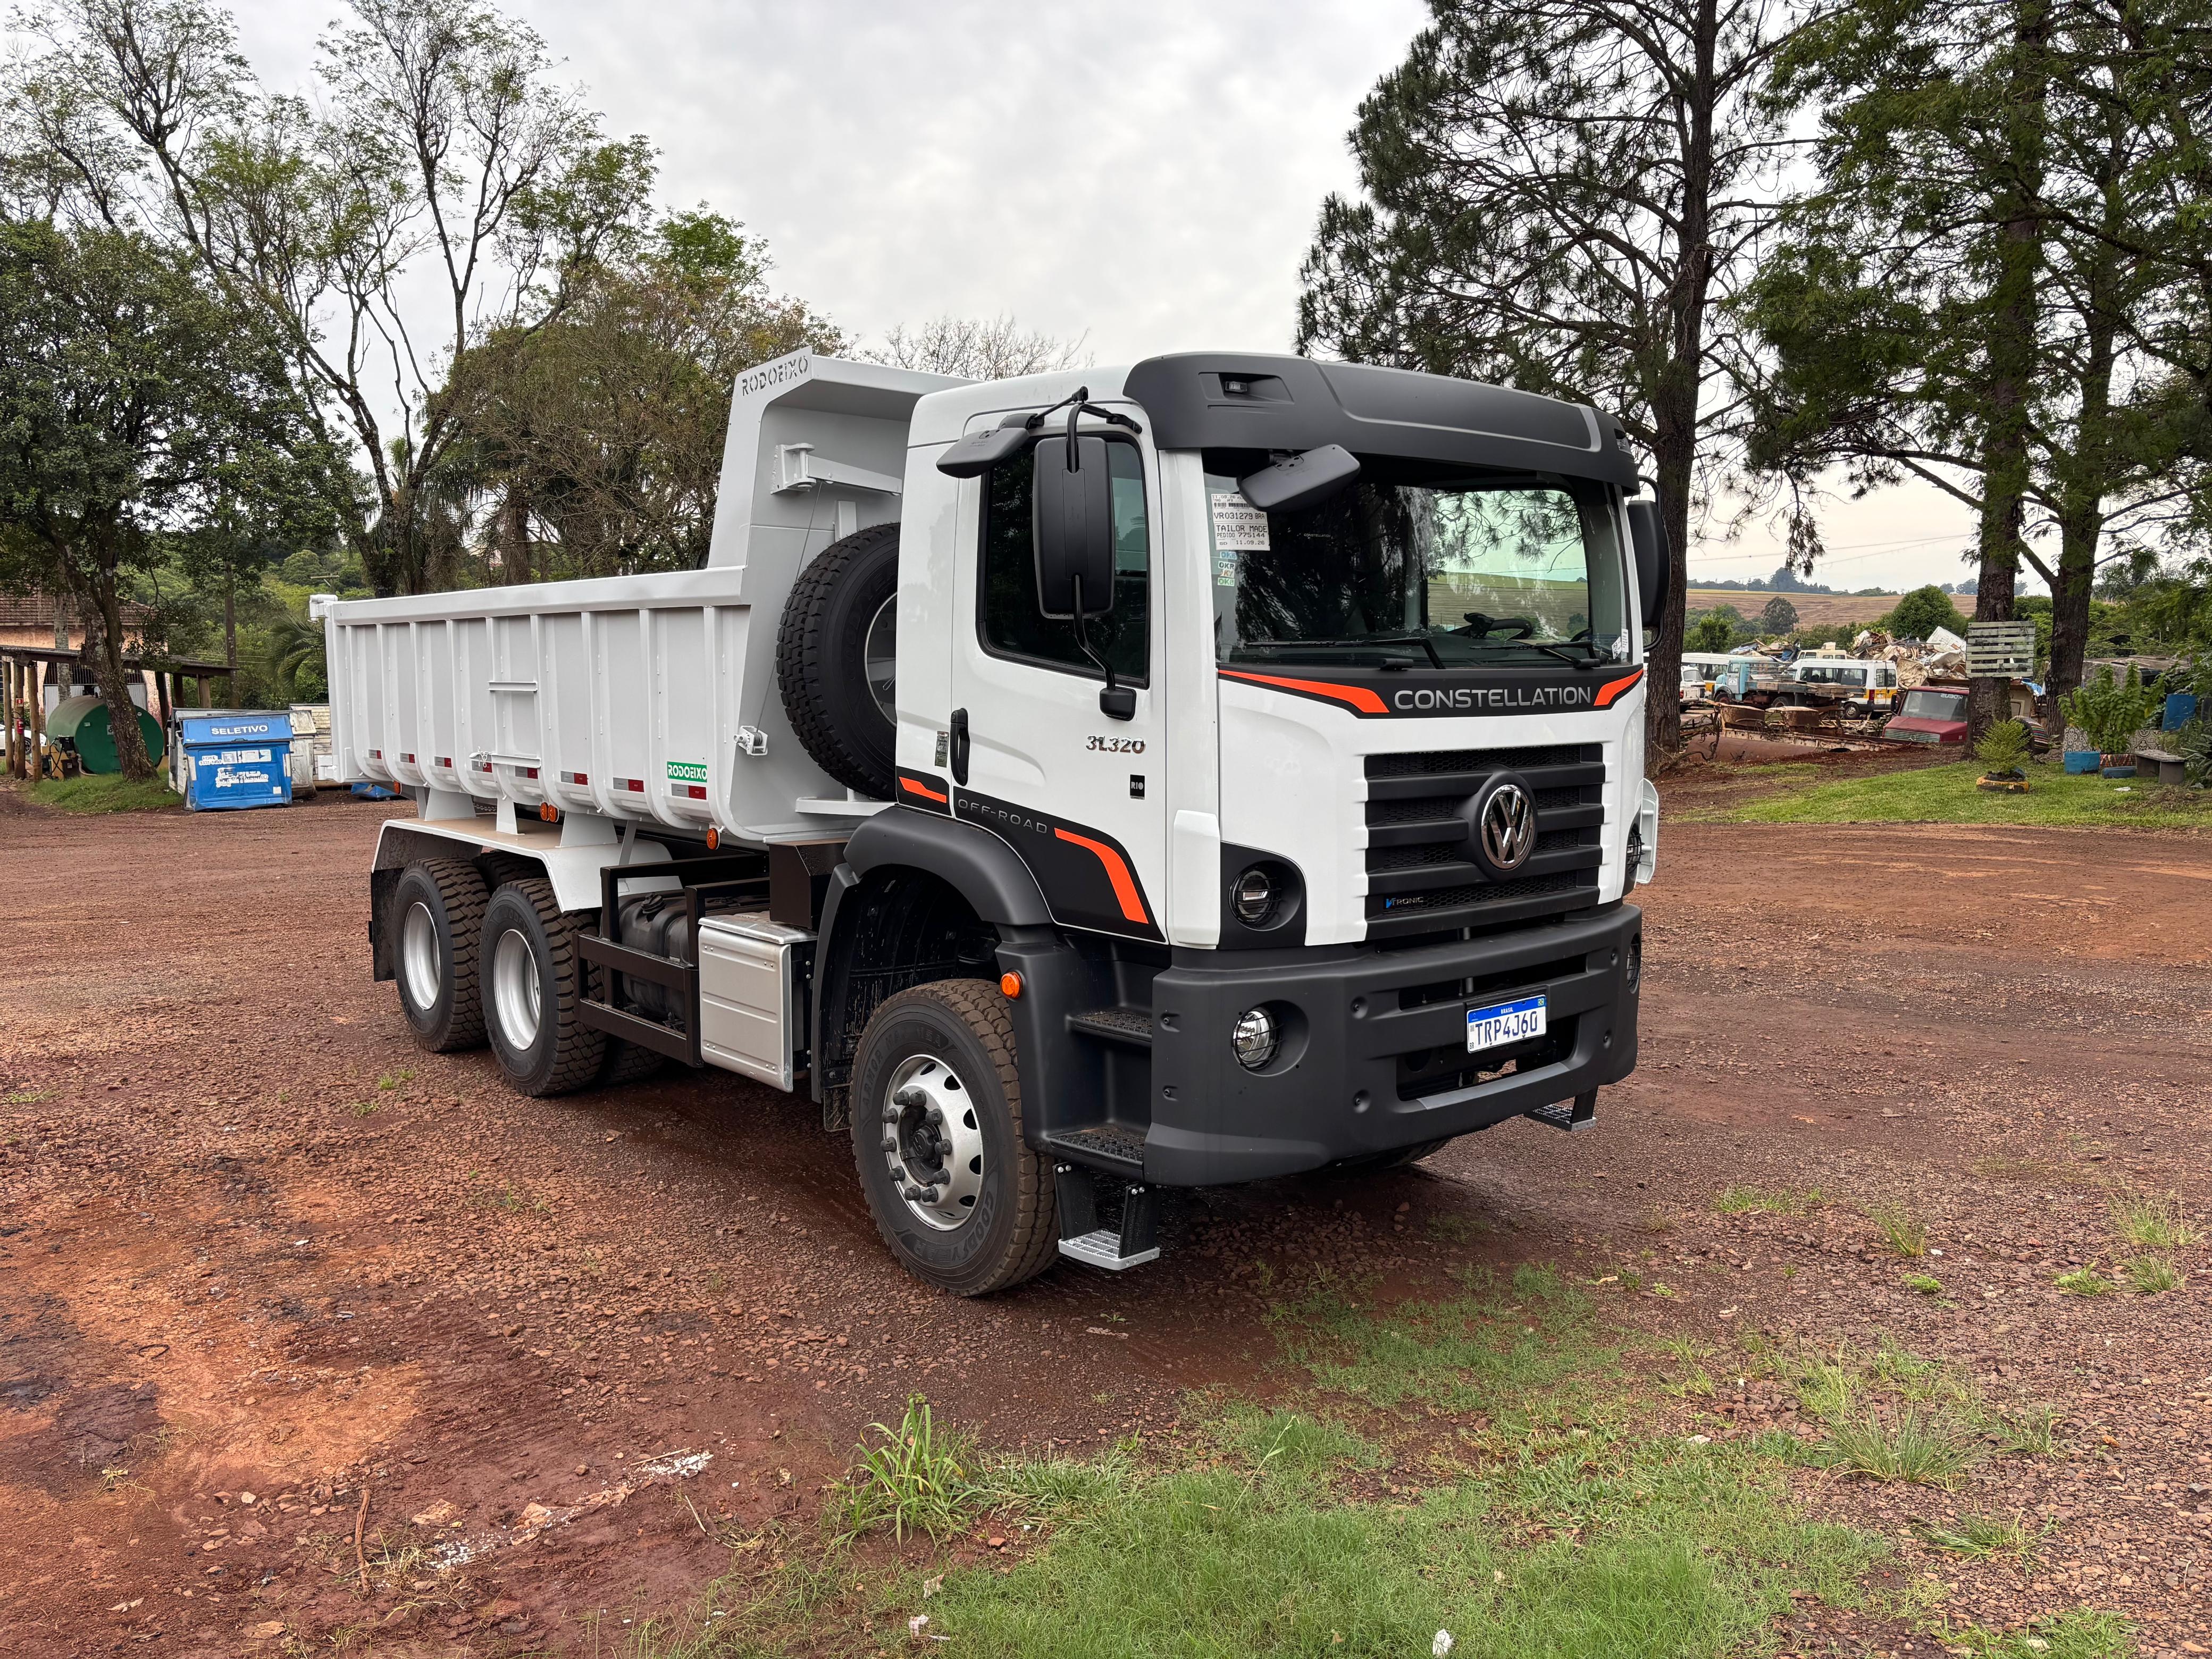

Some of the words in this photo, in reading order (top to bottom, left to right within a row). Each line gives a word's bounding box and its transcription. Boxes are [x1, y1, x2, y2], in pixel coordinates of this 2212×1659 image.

[742, 355, 808, 396] RODOEIXO
[1394, 686, 1591, 710] CONSTELLATION
[211, 725, 269, 735] SELETIVO
[668, 764, 707, 780] RODOEIXO
[1130, 781, 1144, 790] RIO
[958, 799, 1048, 834] OFF-ROAD
[1475, 1011, 1538, 1045] TRP4J60
[913, 1191, 994, 1263] GOODYEAR
